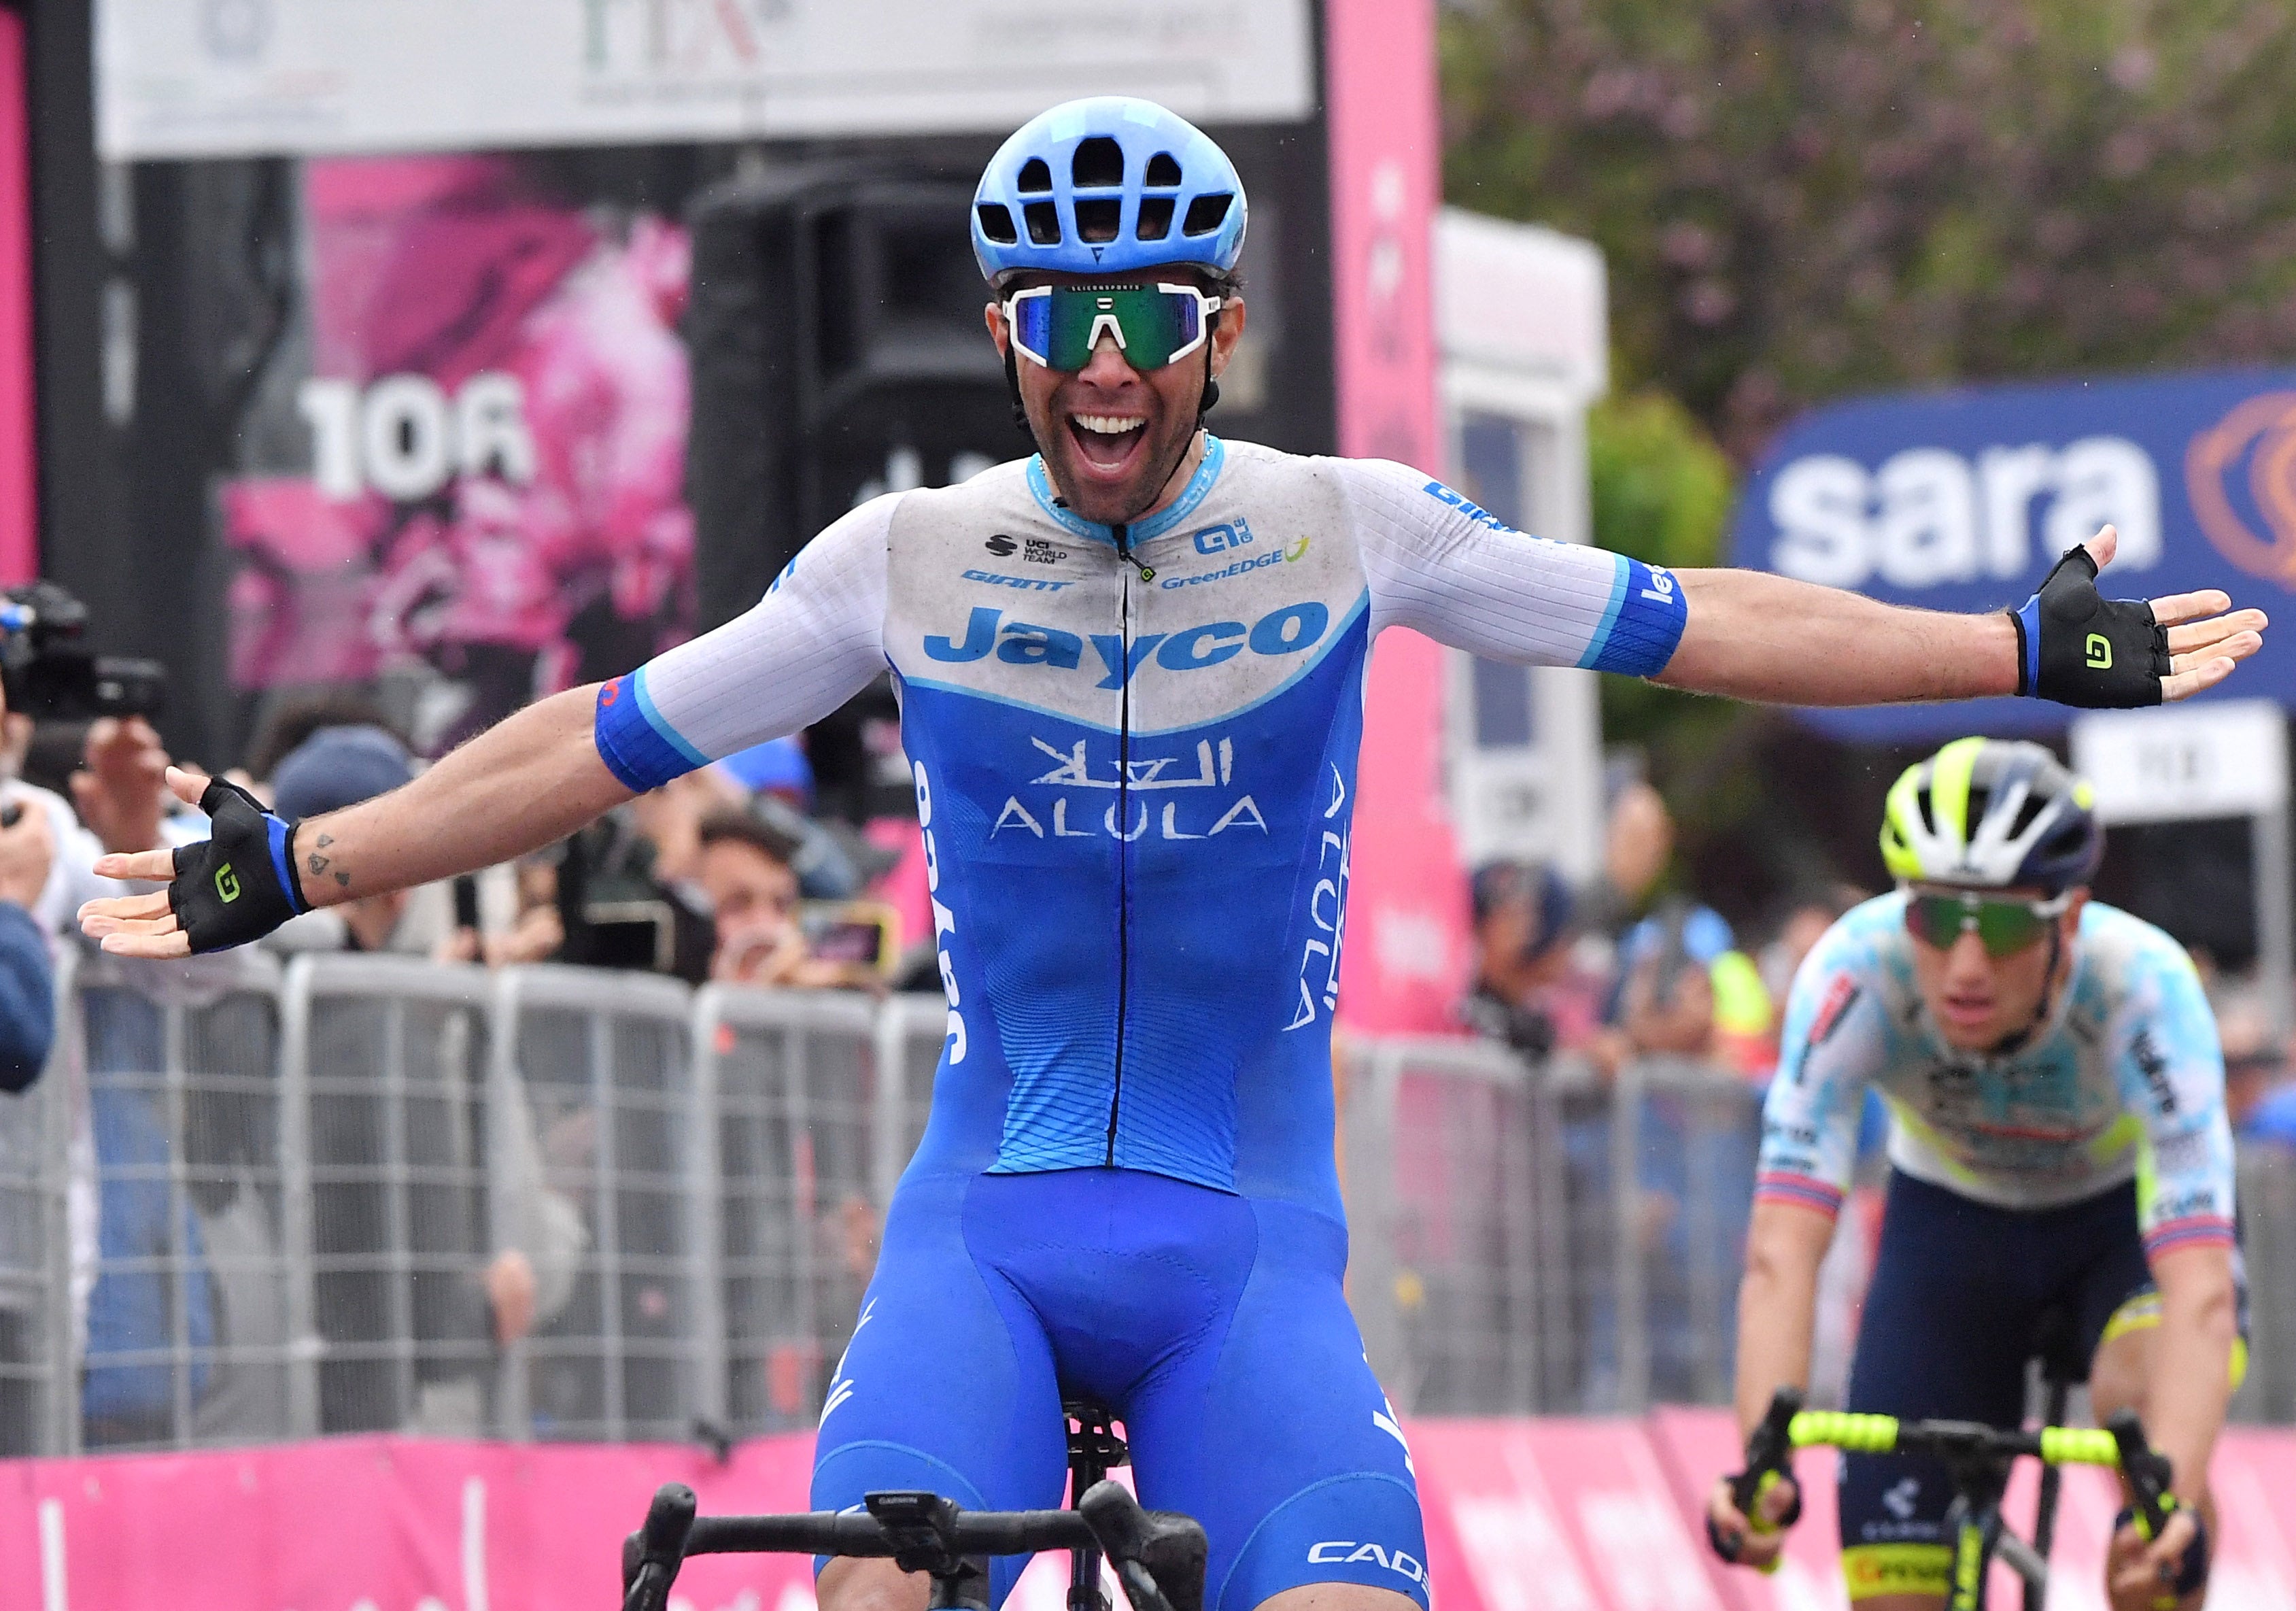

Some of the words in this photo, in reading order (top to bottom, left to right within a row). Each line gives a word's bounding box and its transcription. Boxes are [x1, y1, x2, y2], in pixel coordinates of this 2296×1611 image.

[1768, 435, 2163, 589] sara
[1023, 554, 1056, 565] TEAM
[1024, 546, 1067, 560] WORLD
[1025, 539, 1050, 549] UCI
[961, 569, 1076, 592] GIANT
[1161, 549, 1283, 590] GreenEDGE
[923, 601, 1330, 690] Jayco
[990, 794, 1269, 842] ALULA
[1282, 760, 1346, 1032] ALULA
